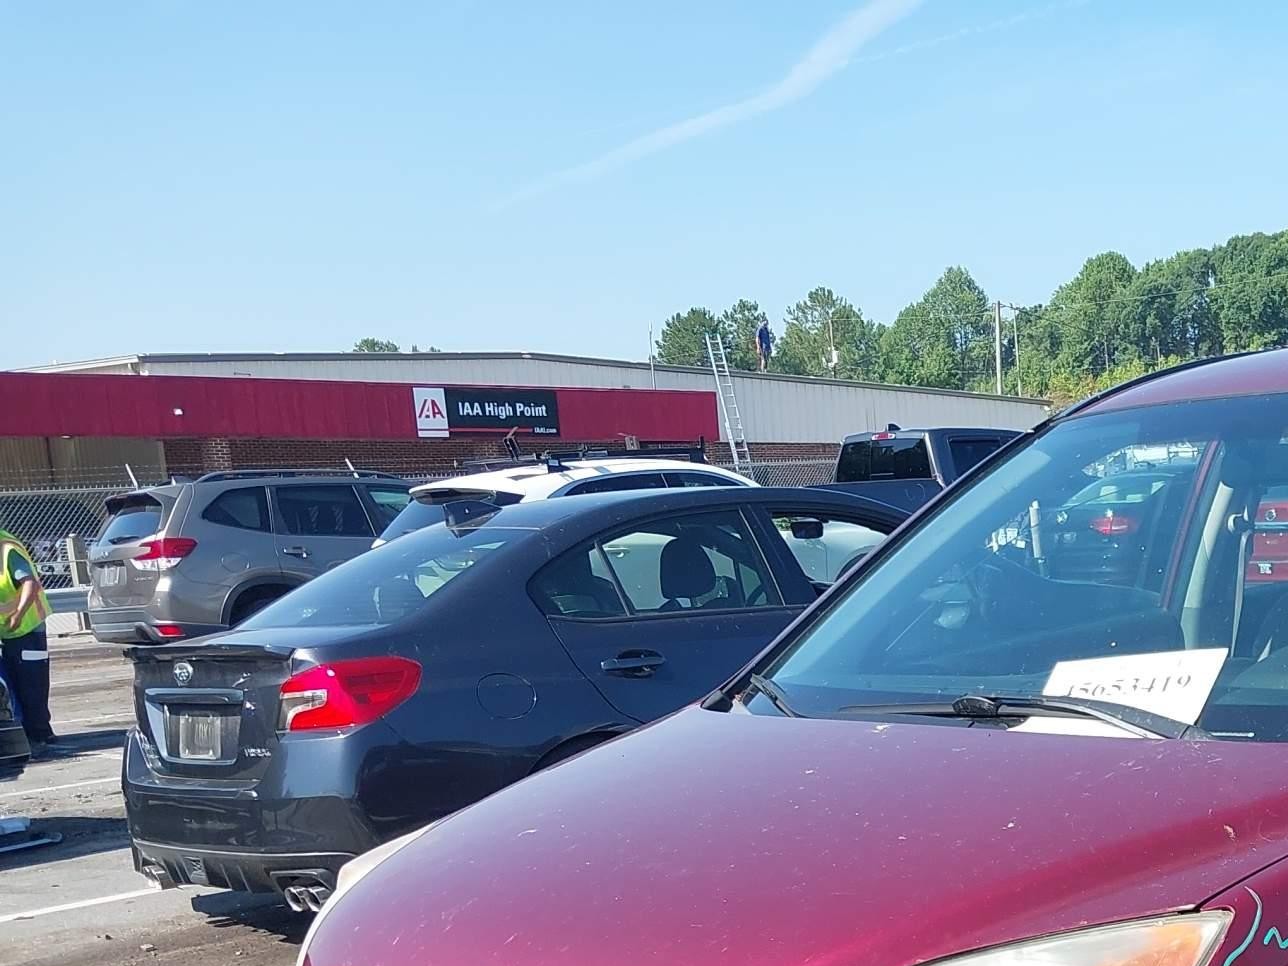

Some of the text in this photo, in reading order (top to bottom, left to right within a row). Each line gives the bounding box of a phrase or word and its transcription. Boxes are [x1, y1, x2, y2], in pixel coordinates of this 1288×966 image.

[458, 402, 547, 419] IAA High Point
